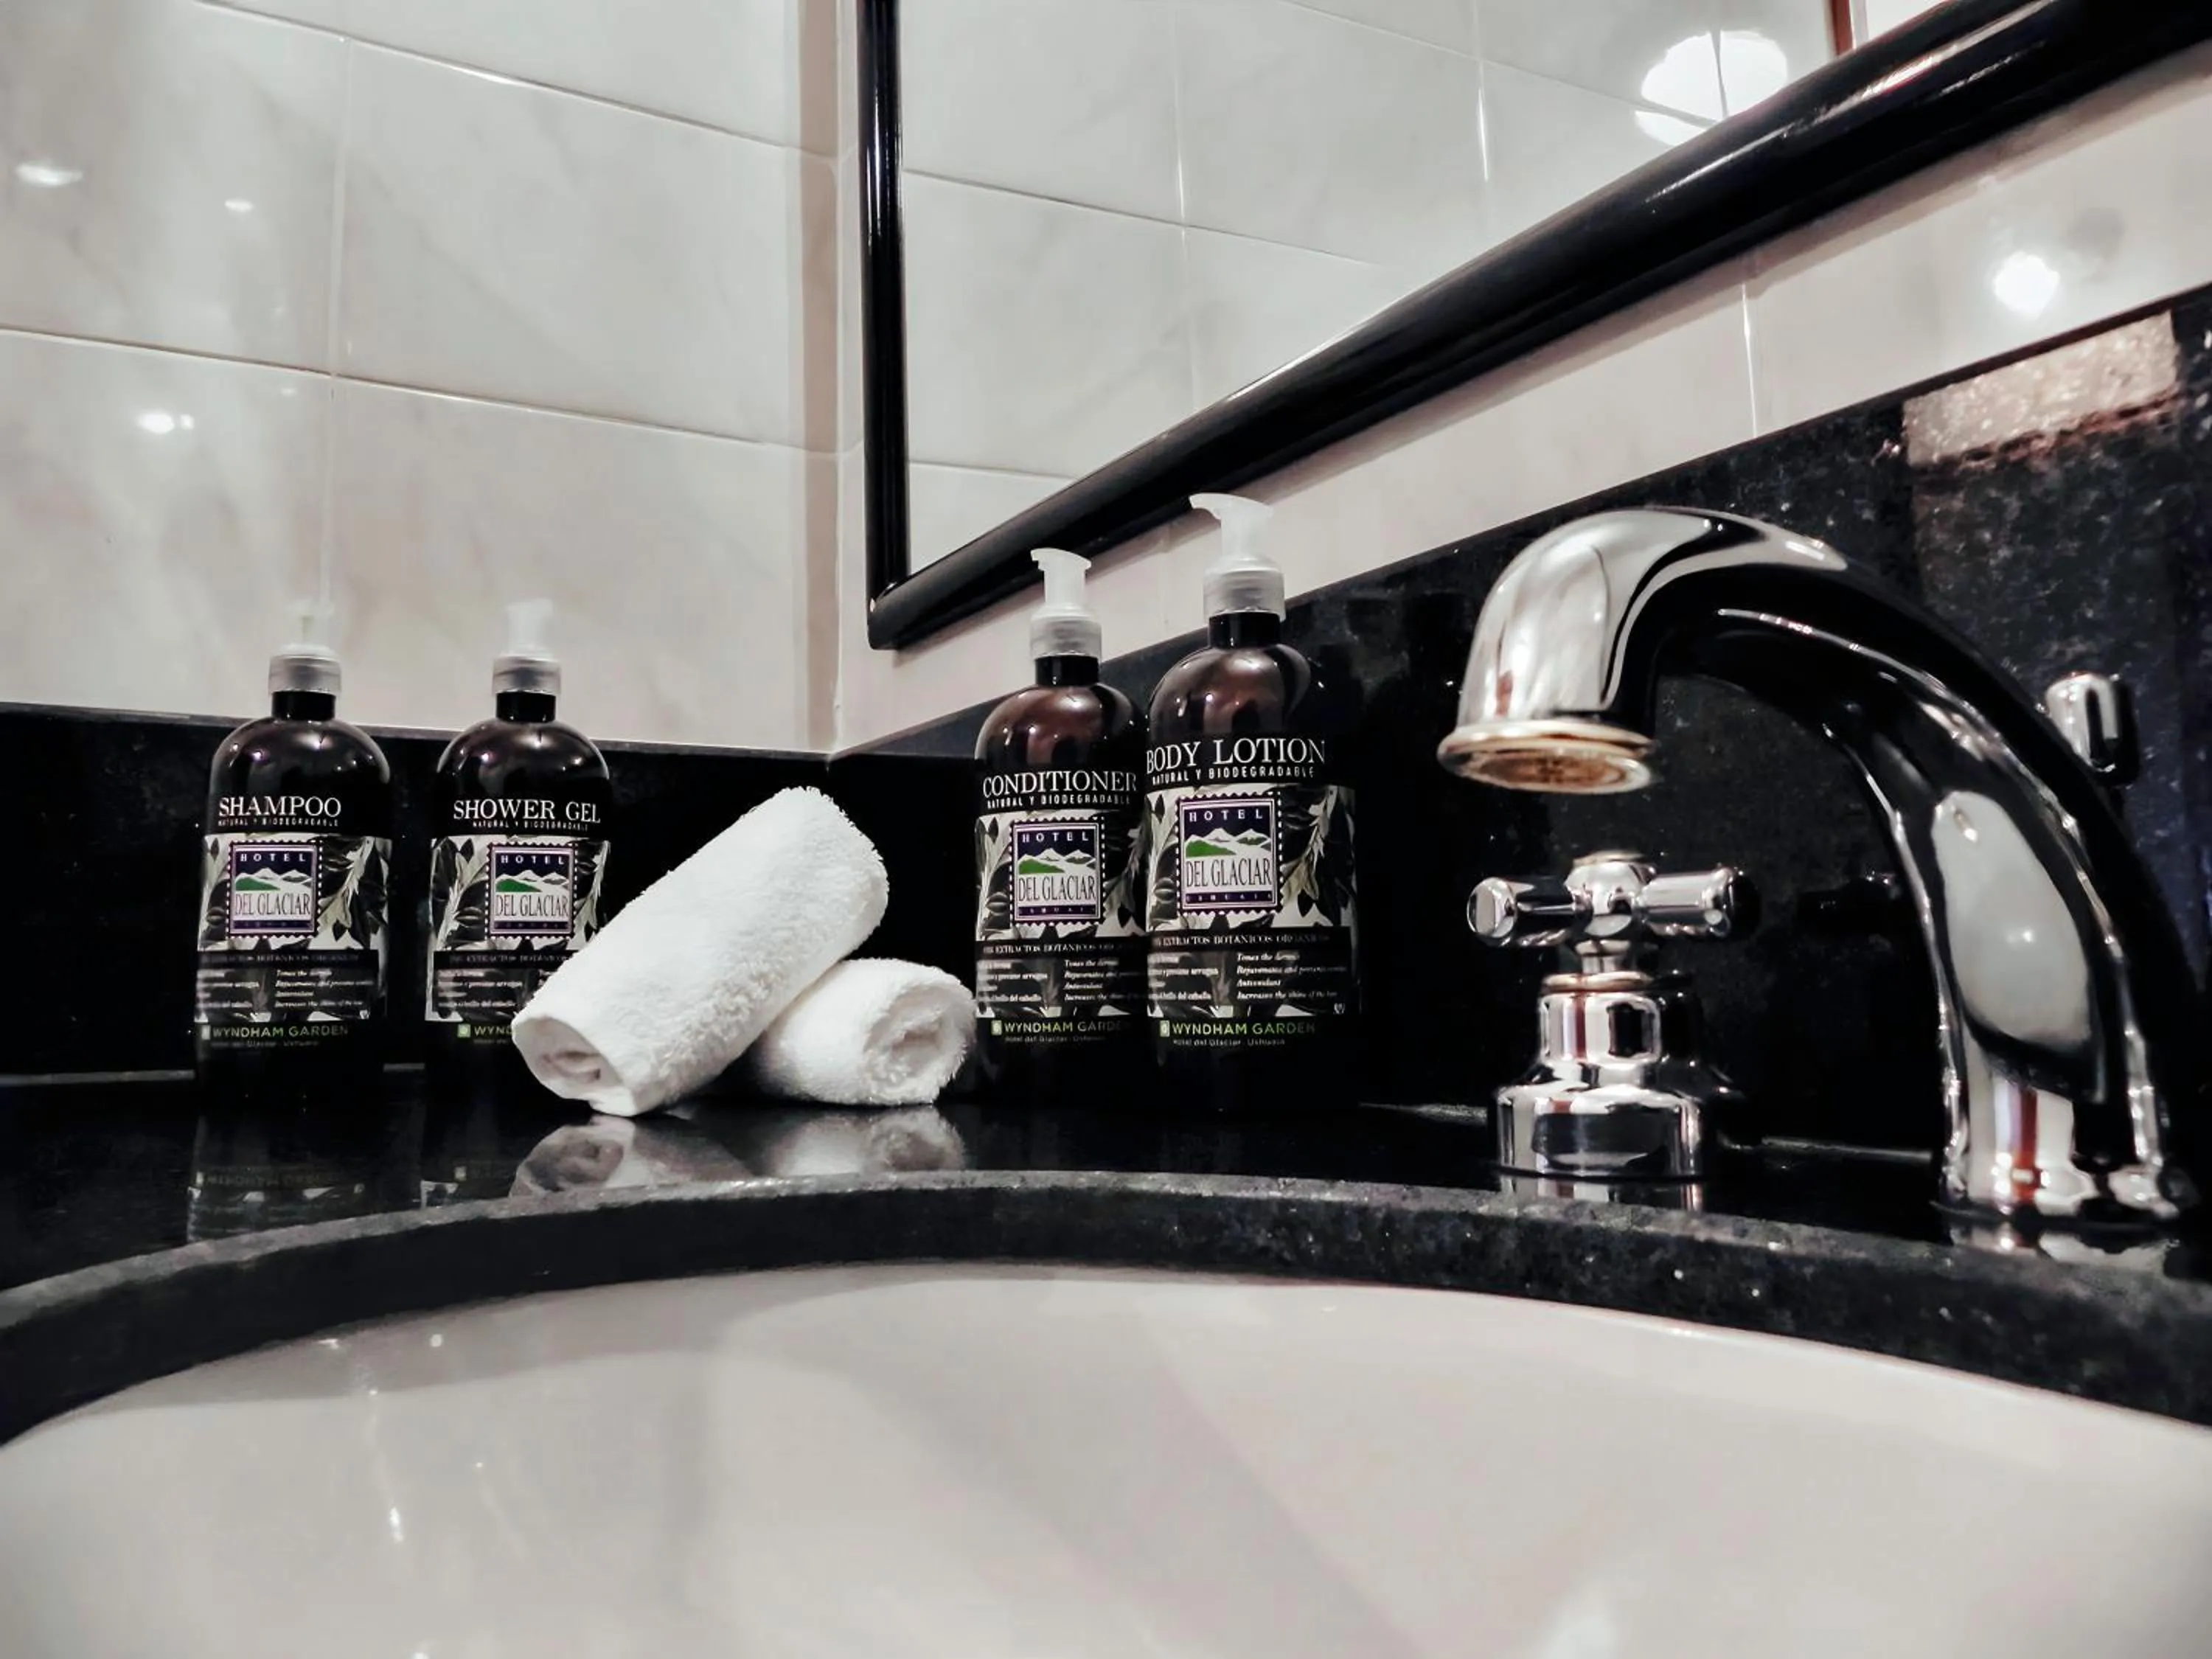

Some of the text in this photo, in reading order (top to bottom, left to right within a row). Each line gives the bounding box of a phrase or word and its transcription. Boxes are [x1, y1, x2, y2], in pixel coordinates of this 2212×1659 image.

[1147, 737, 1326, 775] BODY LOTION
[983, 770, 1138, 799] CONDITIONER
[1152, 765, 1315, 786] NATURAL Y BIODEGRADABLE
[218, 796, 341, 818] SHAMPOO
[453, 798, 601, 824] SHOWER GEL
[1189, 808, 1263, 822] HOTEL
[1022, 831, 1089, 843] HOTEL
[240, 853, 306, 862] HOTEL
[501, 855, 565, 865] HOTEL
[1186, 858, 1271, 887] DEL GLACIAR
[1018, 875, 1096, 902] DEL GLACIAR
[236, 893, 310, 915] DEL GLACIAR
[495, 894, 569, 917] DEL GLACIAR
[212, 1024, 349, 1038] WYNDHAM GARDEN
[1004, 1022, 1074, 1034] WYNDHAM
[1172, 1021, 1315, 1035] WYNDHAM GARDEN
